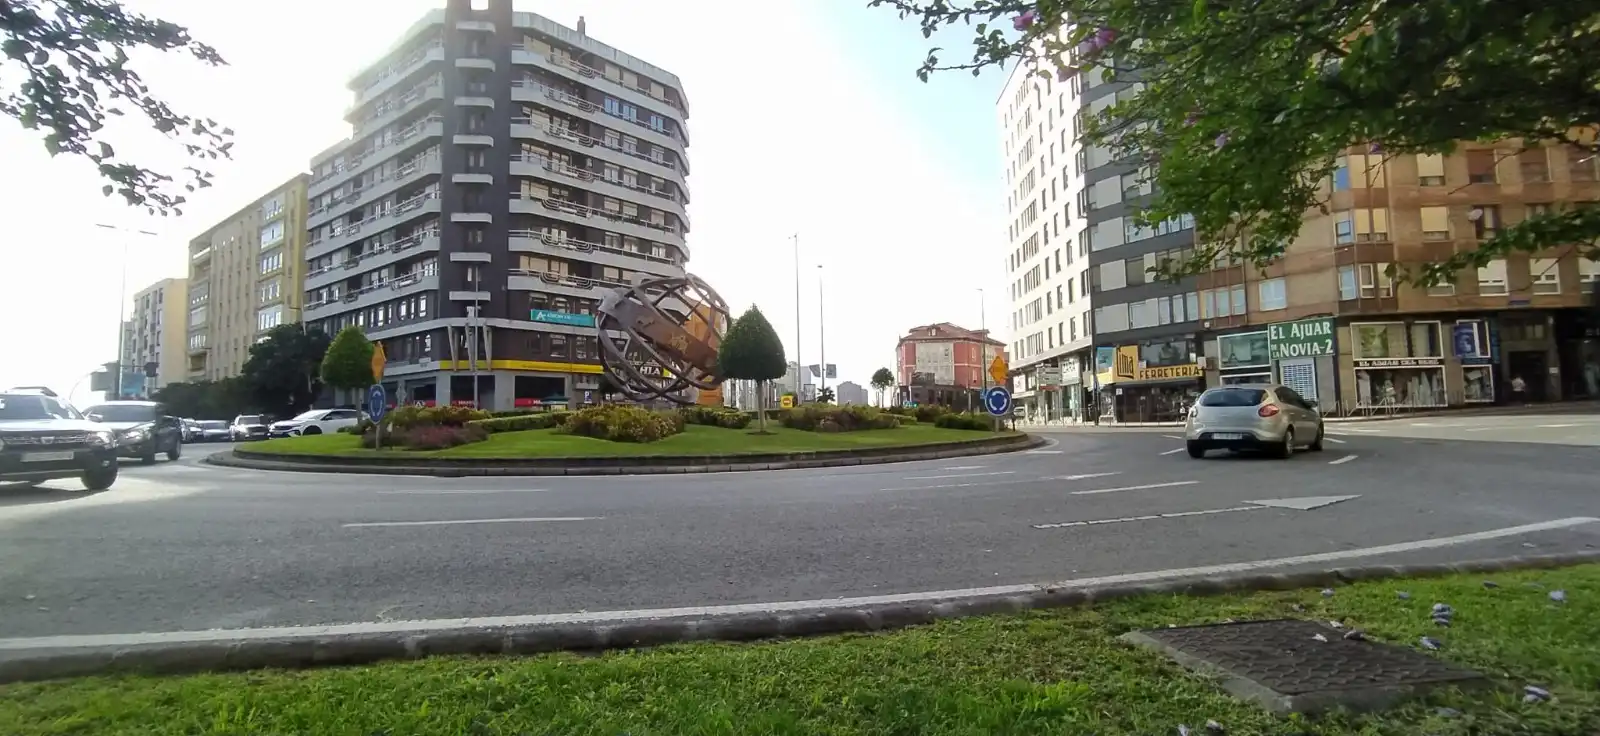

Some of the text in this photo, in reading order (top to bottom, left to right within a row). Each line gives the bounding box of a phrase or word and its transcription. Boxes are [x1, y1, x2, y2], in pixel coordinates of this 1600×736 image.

[1270, 321, 1332, 340] EL AJUAR
[1279, 339, 1334, 358] NOVIA-2
[1139, 366, 1200, 380] FERRETERIA
